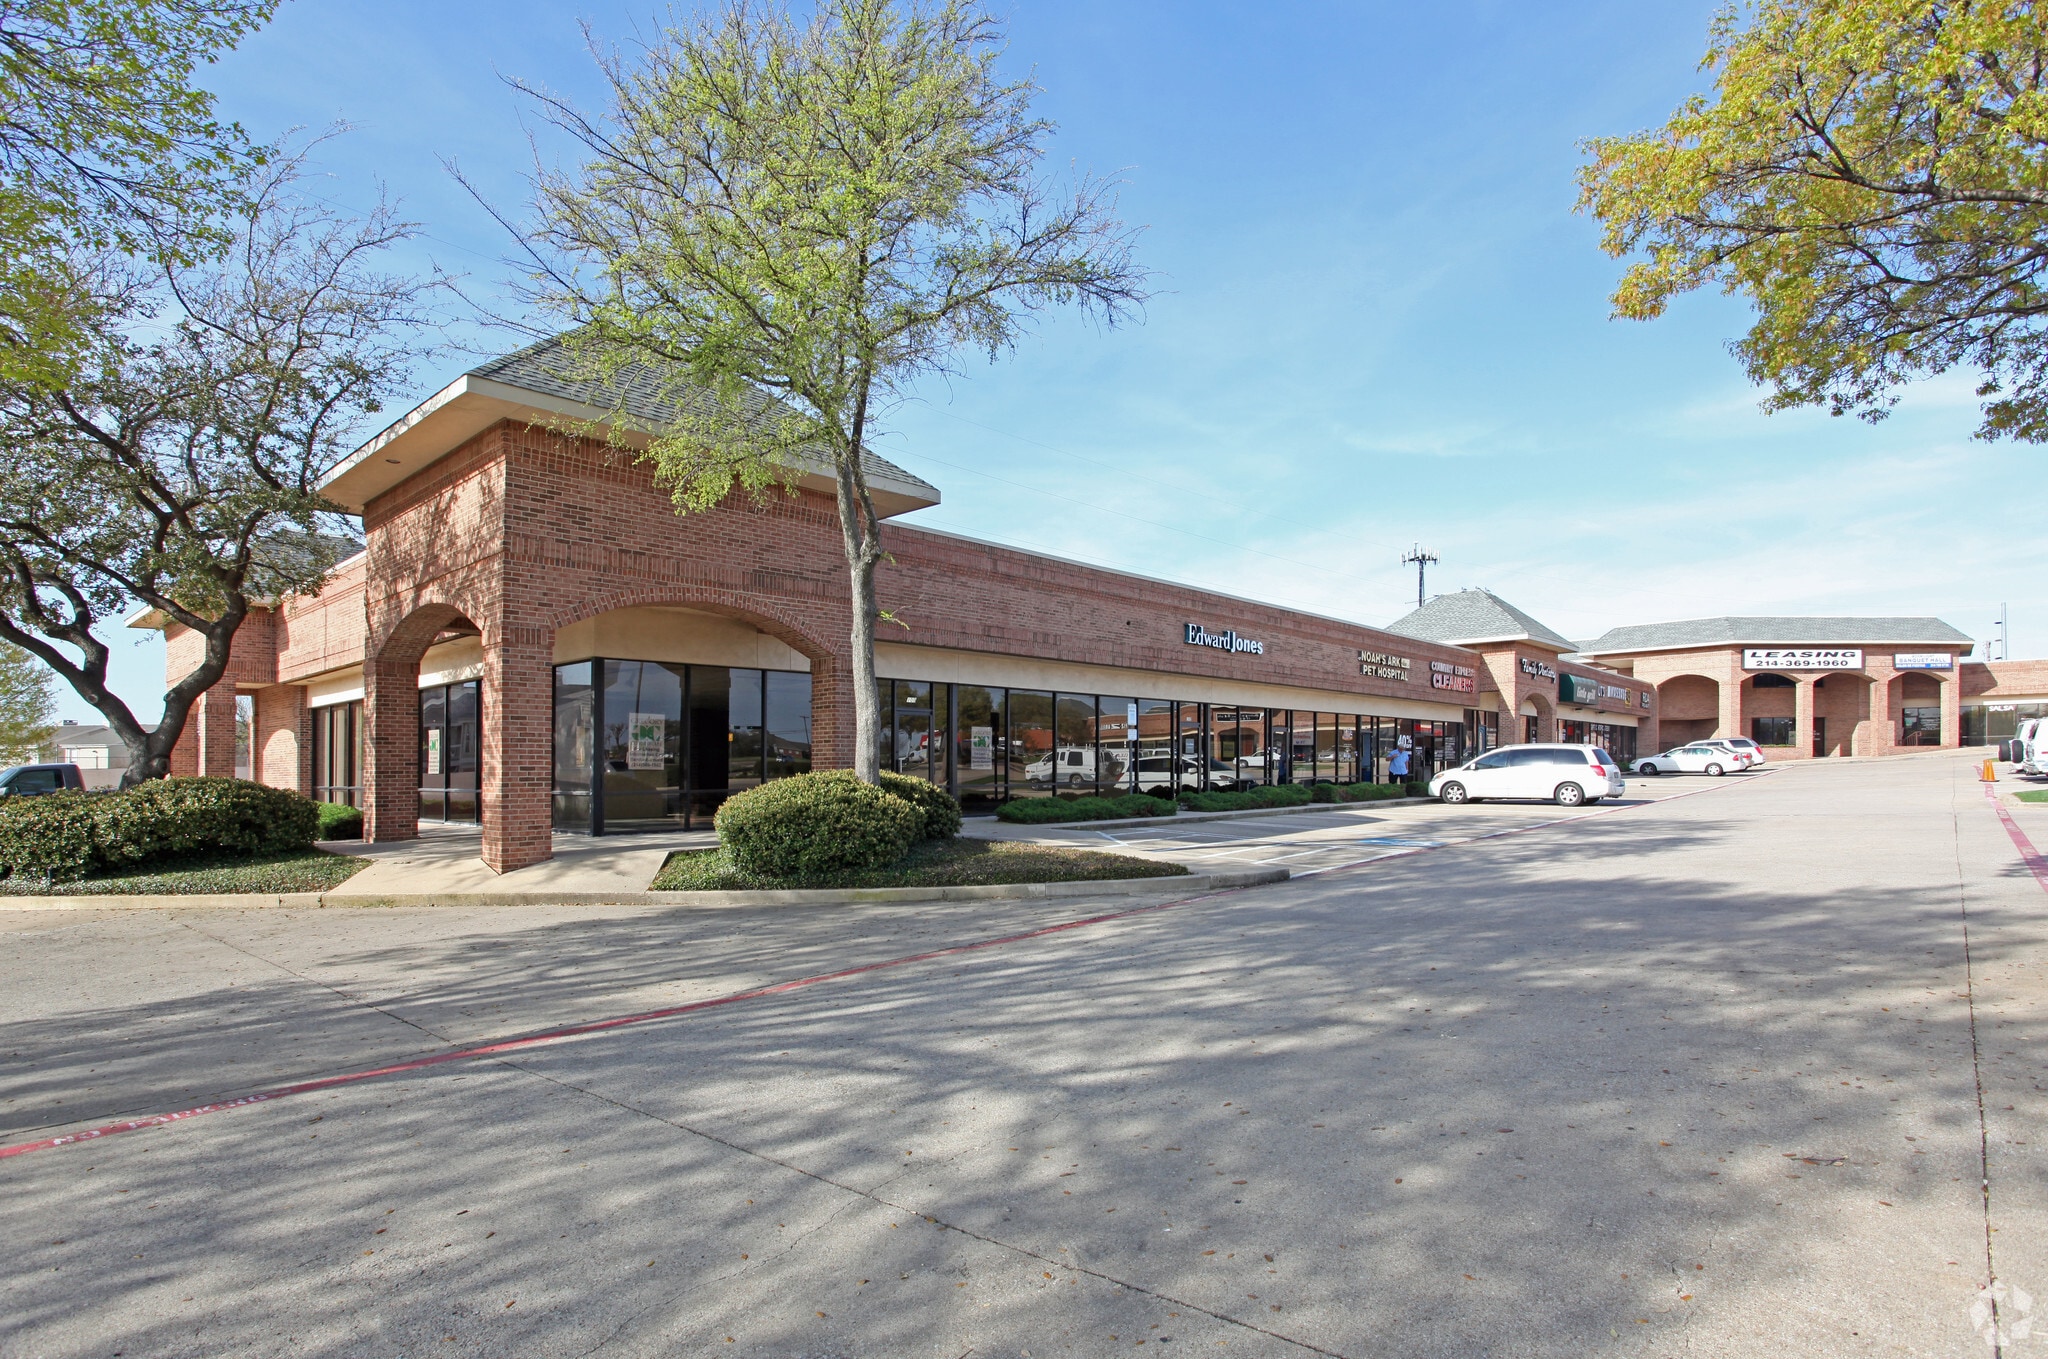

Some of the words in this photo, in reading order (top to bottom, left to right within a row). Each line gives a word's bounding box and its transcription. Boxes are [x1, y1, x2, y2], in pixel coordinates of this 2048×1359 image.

[1187, 623, 1232, 651] Edward
[1232, 631, 1264, 655] Jones
[1361, 650, 1386, 665] NOAH'S
[1387, 655, 1401, 668] ARK
[1363, 664, 1376, 676] PET
[1377, 667, 1409, 681] HOSPITAL
[1432, 673, 1475, 693] CLEANERS
